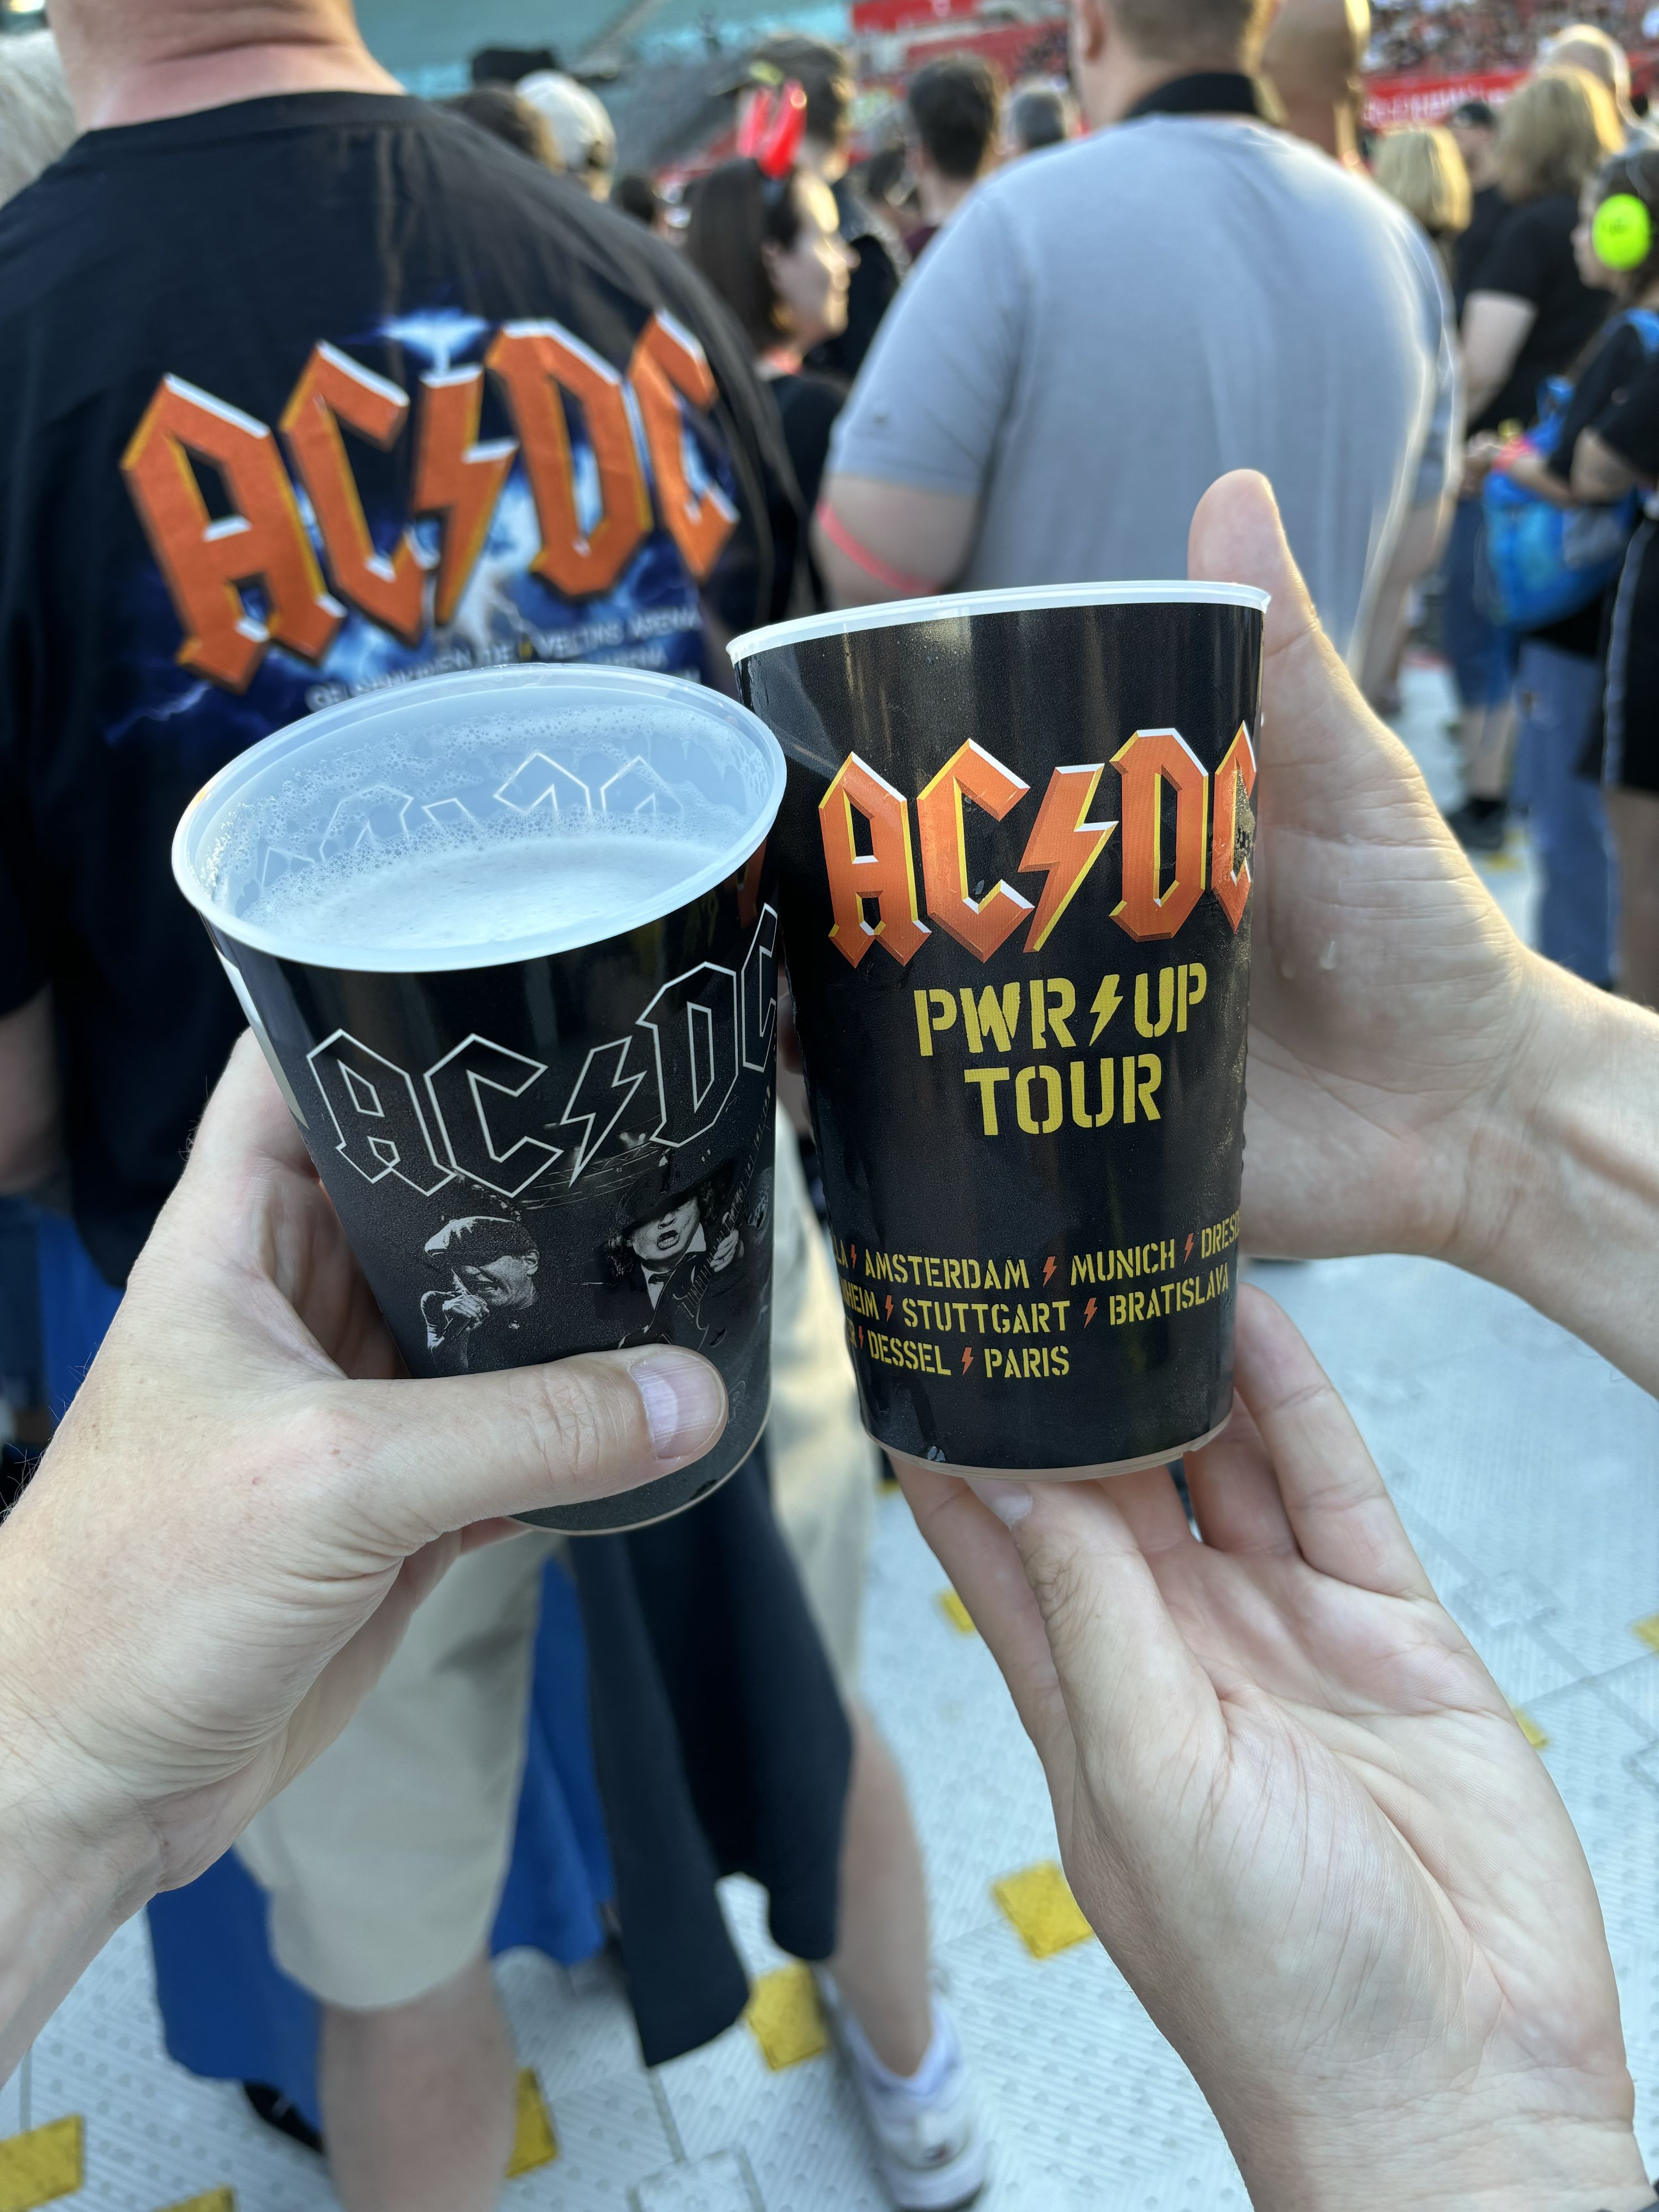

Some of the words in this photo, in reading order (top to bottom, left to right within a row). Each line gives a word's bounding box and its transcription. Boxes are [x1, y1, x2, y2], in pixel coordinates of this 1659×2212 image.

[964, 1053, 1162, 1136] TOUR
[865, 1248, 1030, 1290] AMSTERDAM
[1071, 1239, 1175, 1286] MUNICH
[902, 1297, 1071, 1334] STUTTGART
[1109, 1262, 1229, 1326] BRATISLAVA
[867, 1329, 952, 1376] DESSEL
[984, 1345, 1070, 1379] PARIS
